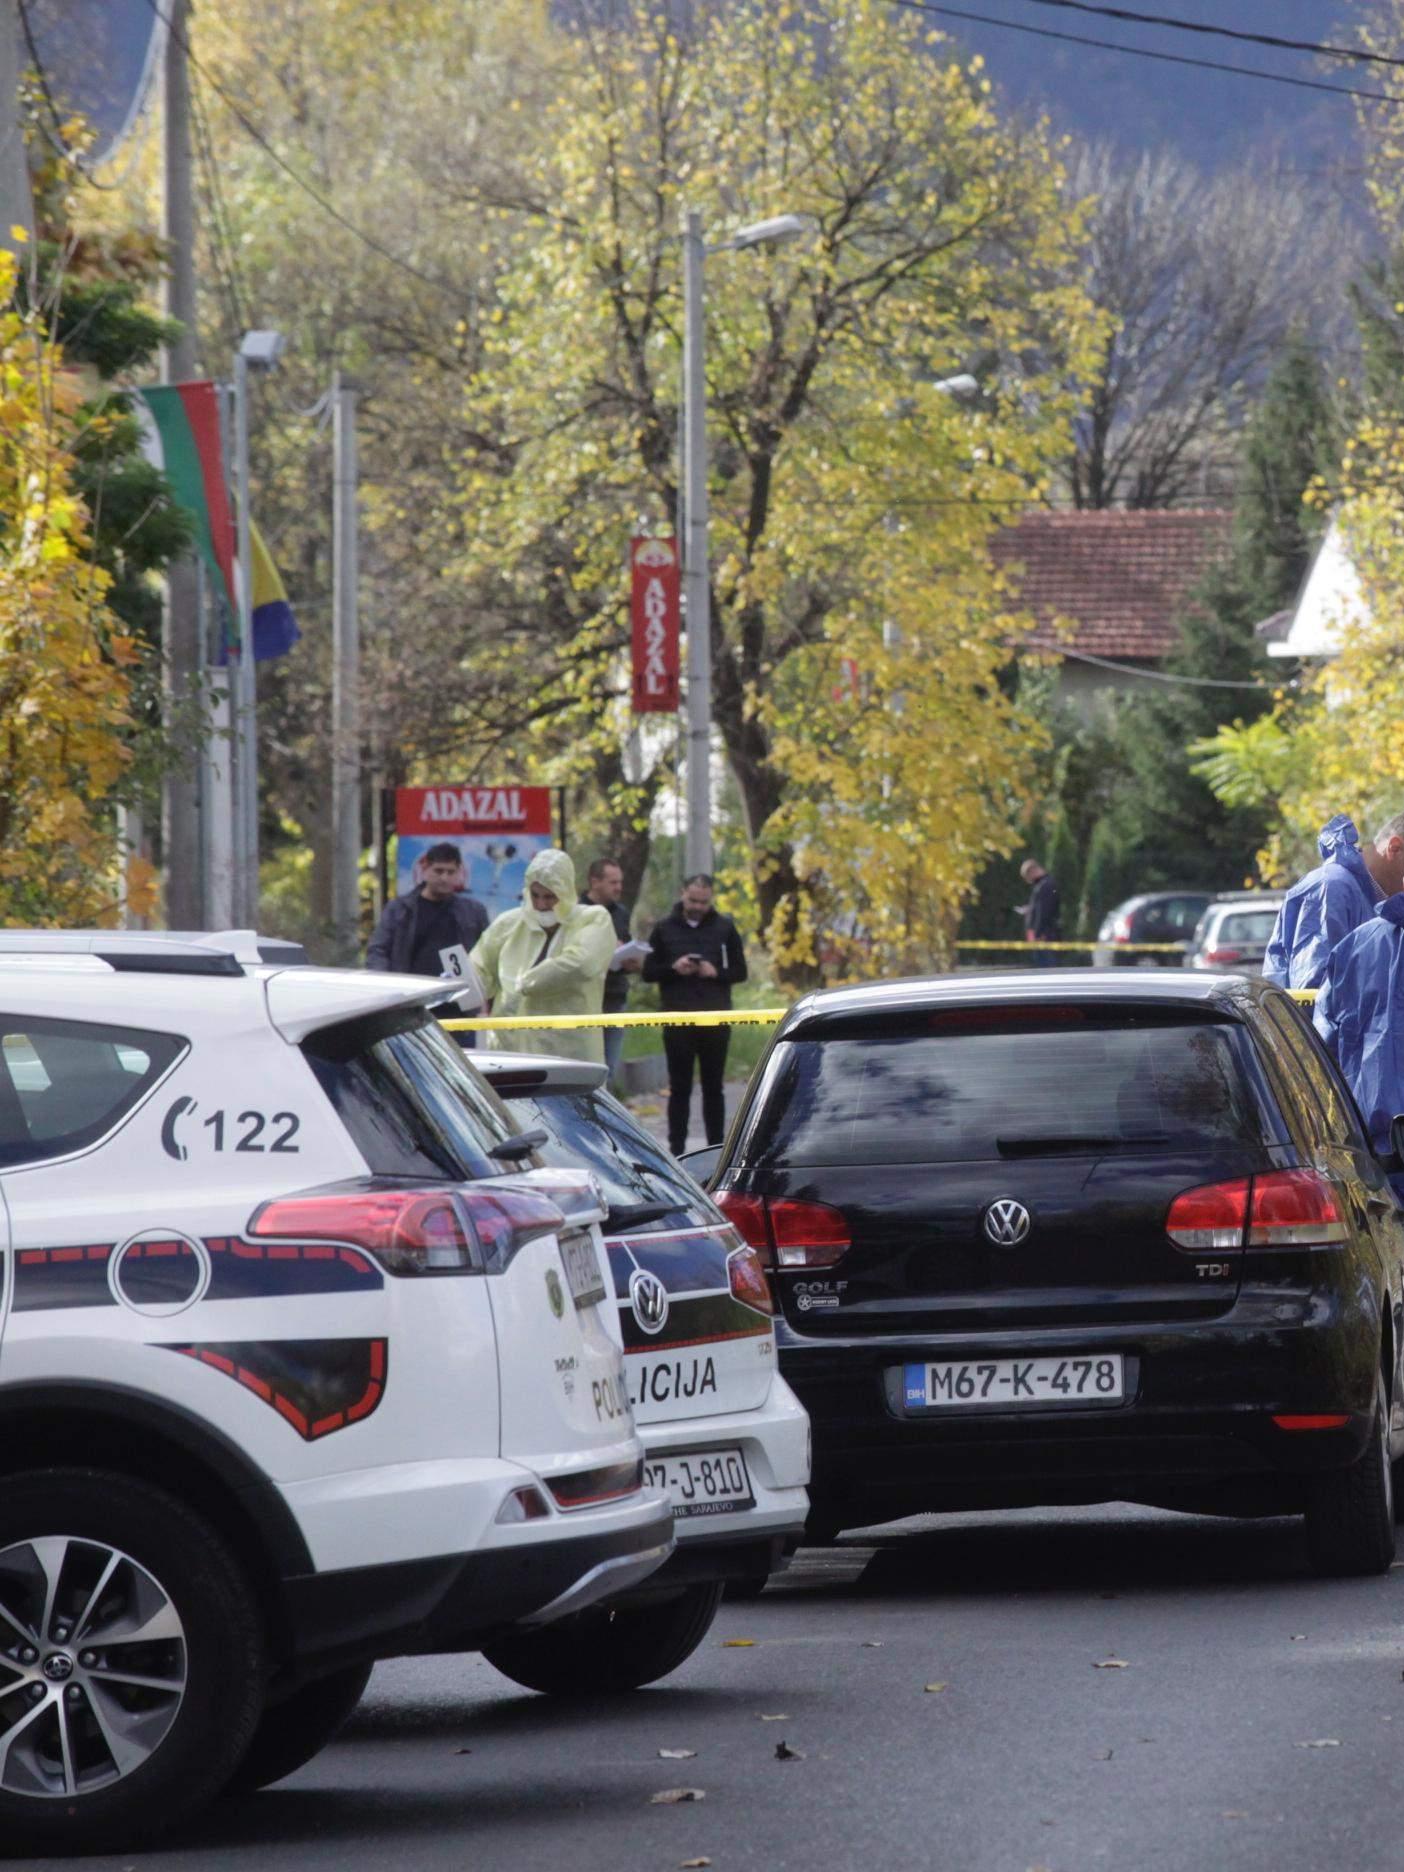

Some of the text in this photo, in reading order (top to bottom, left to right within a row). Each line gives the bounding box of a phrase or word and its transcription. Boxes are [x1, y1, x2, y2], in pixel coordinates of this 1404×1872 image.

[420, 790, 527, 822] ADAZAL
[449, 953, 461, 976] 3
[203, 1110, 300, 1153] 122
[1195, 1263, 1230, 1277] TDI
[792, 1281, 848, 1295] GOLF
[630, 1355, 717, 1405] ICIJA
[930, 1359, 1116, 1400] M67-K-478
